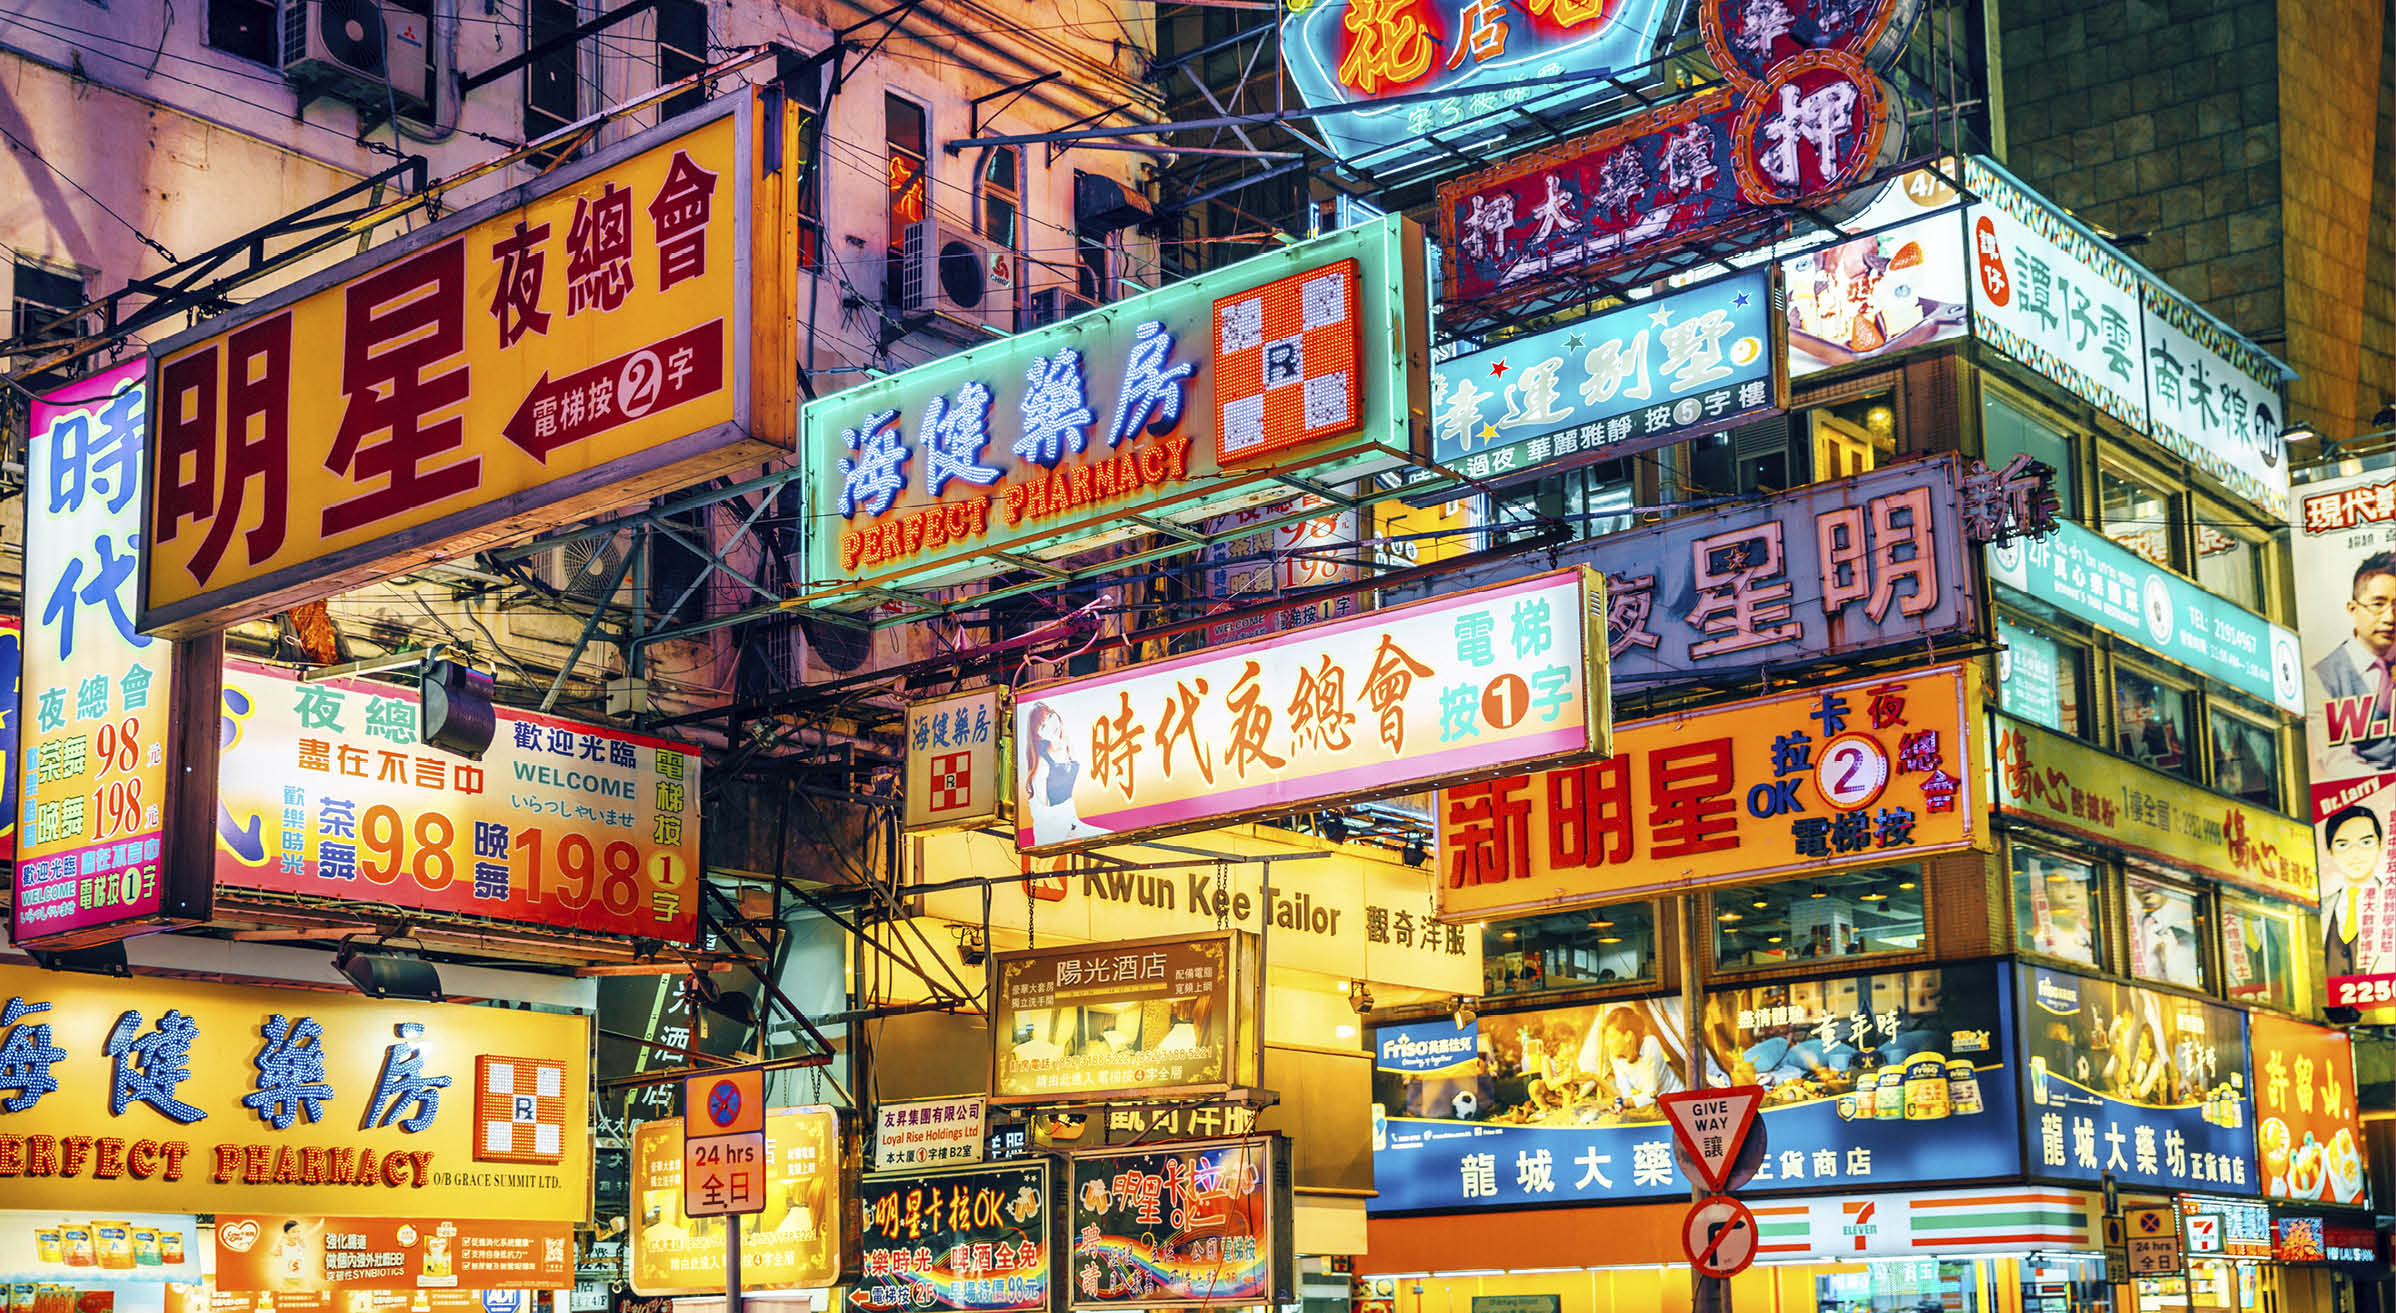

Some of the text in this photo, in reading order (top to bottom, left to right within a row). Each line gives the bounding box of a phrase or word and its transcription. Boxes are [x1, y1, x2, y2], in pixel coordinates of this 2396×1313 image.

[490, 149, 718, 350] 夜總會
[837, 320, 1197, 518] 海健藥房
[840, 438, 1193, 571] PERFECT PHARMACY
[1214, 614, 1265, 635] WELCOME
[1454, 596, 1553, 669] 電梯
[38, 662, 153, 732] 夜總會
[1090, 634, 1435, 801] 時代夜總會
[2325, 693, 2396, 748] W.
[95, 716, 140, 780] 98
[513, 721, 638, 770] 歡迎光臨
[912, 704, 991, 751] 海健藥房
[298, 737, 484, 795] 盡在不言中
[512, 760, 636, 801] WELCOME
[91, 777, 143, 842] 198
[281, 784, 305, 876] 歡樂時光
[1448, 737, 1741, 889] 新明星
[361, 804, 455, 891] 98
[515, 827, 641, 918] 198
[21, 880, 76, 907] WELCOME
[1084, 853, 1341, 937] Kwun Kee Tailor
[1366, 906, 1467, 956] 觀奇洋服
[1056, 952, 1168, 988] 陽光酒店
[1383, 1038, 1428, 1060] Friso
[884, 1103, 980, 1128] 友昇集團有限公司
[1693, 1100, 1729, 1117] GIVE
[1695, 1116, 1728, 1133] WAY
[695, 1144, 754, 1167] 24 hrs
[882, 1124, 978, 1147] Loyal Rise Holdings Ltd
[1703, 1134, 1724, 1160] 讓
[2041, 1112, 2187, 1177] 龍城大藥坊
[214, 1143, 435, 1188] PHARMACY
[433, 1172, 562, 1190] O/B GRACE SUMMIT LTD.
[702, 1172, 749, 1207] 全日
[1843, 1200, 1875, 1251] 7
[2136, 1241, 2171, 1252] 24 hrs
[951, 1239, 1038, 1273] 啤酒全免
[2140, 1256, 2171, 1273] 全日
